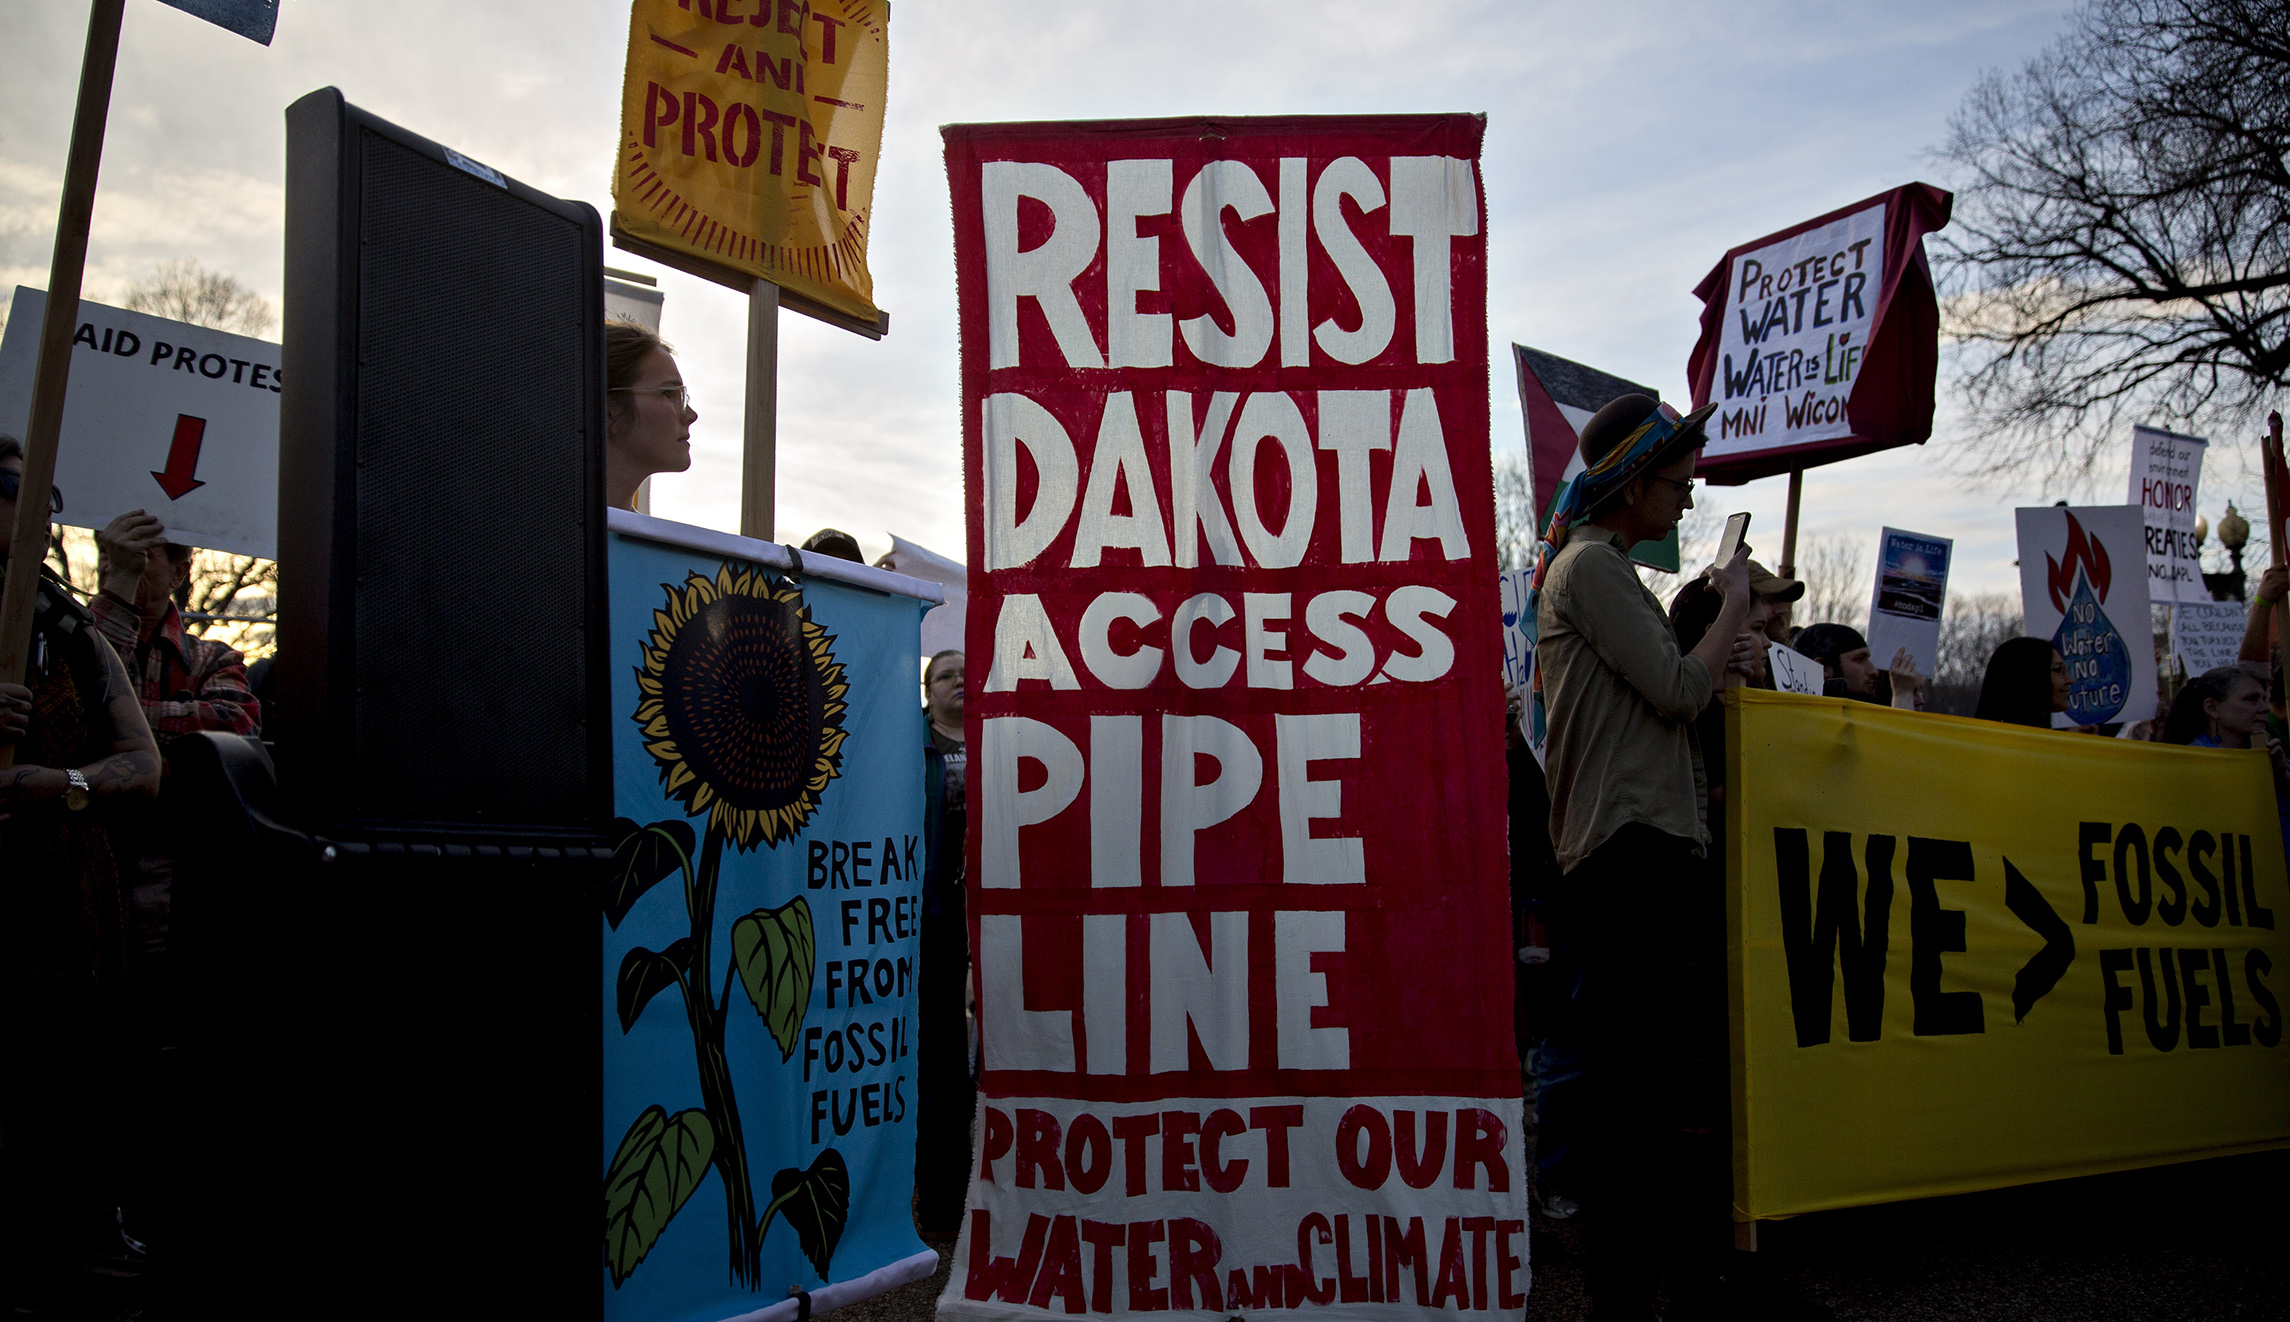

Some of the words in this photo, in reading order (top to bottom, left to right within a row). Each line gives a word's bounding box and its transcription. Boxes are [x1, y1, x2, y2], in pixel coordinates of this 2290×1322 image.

[643, 81, 860, 211] PROTET
[982, 155, 1479, 371] RESIST
[1739, 238, 1872, 304] PROTECT
[73, 322, 141, 357] AID
[1739, 272, 1866, 346] WATER
[1724, 347, 1804, 400] WATER
[982, 387, 1472, 572] DAKOTA
[2142, 477, 2192, 513] HONOR
[2145, 525, 2196, 560] REATIES
[2148, 564, 2166, 579] NO
[983, 586, 1457, 693] ACCESS
[2062, 630, 2113, 657] Water
[2073, 602, 2095, 625] NO
[2069, 683, 2121, 713] uture
[2075, 658, 2098, 680] NO
[981, 713, 1366, 888] PIPE
[808, 834, 919, 889] BREAK
[2078, 821, 2275, 930] FOSSIL
[841, 896, 918, 946] FREE
[1773, 827, 1985, 1048] WE
[826, 956, 912, 1009] FROM
[980, 911, 1350, 1075] LINE
[2100, 947, 2283, 1055] FUELS
[804, 1016, 908, 1082] FOSSIL
[811, 1075, 905, 1144] FUELS
[980, 1104, 1304, 1197] PROTECT
[1336, 1104, 1509, 1192] OUR
[965, 1209, 1223, 1314] WATER
[1298, 1212, 1525, 1310] CLIMATE
